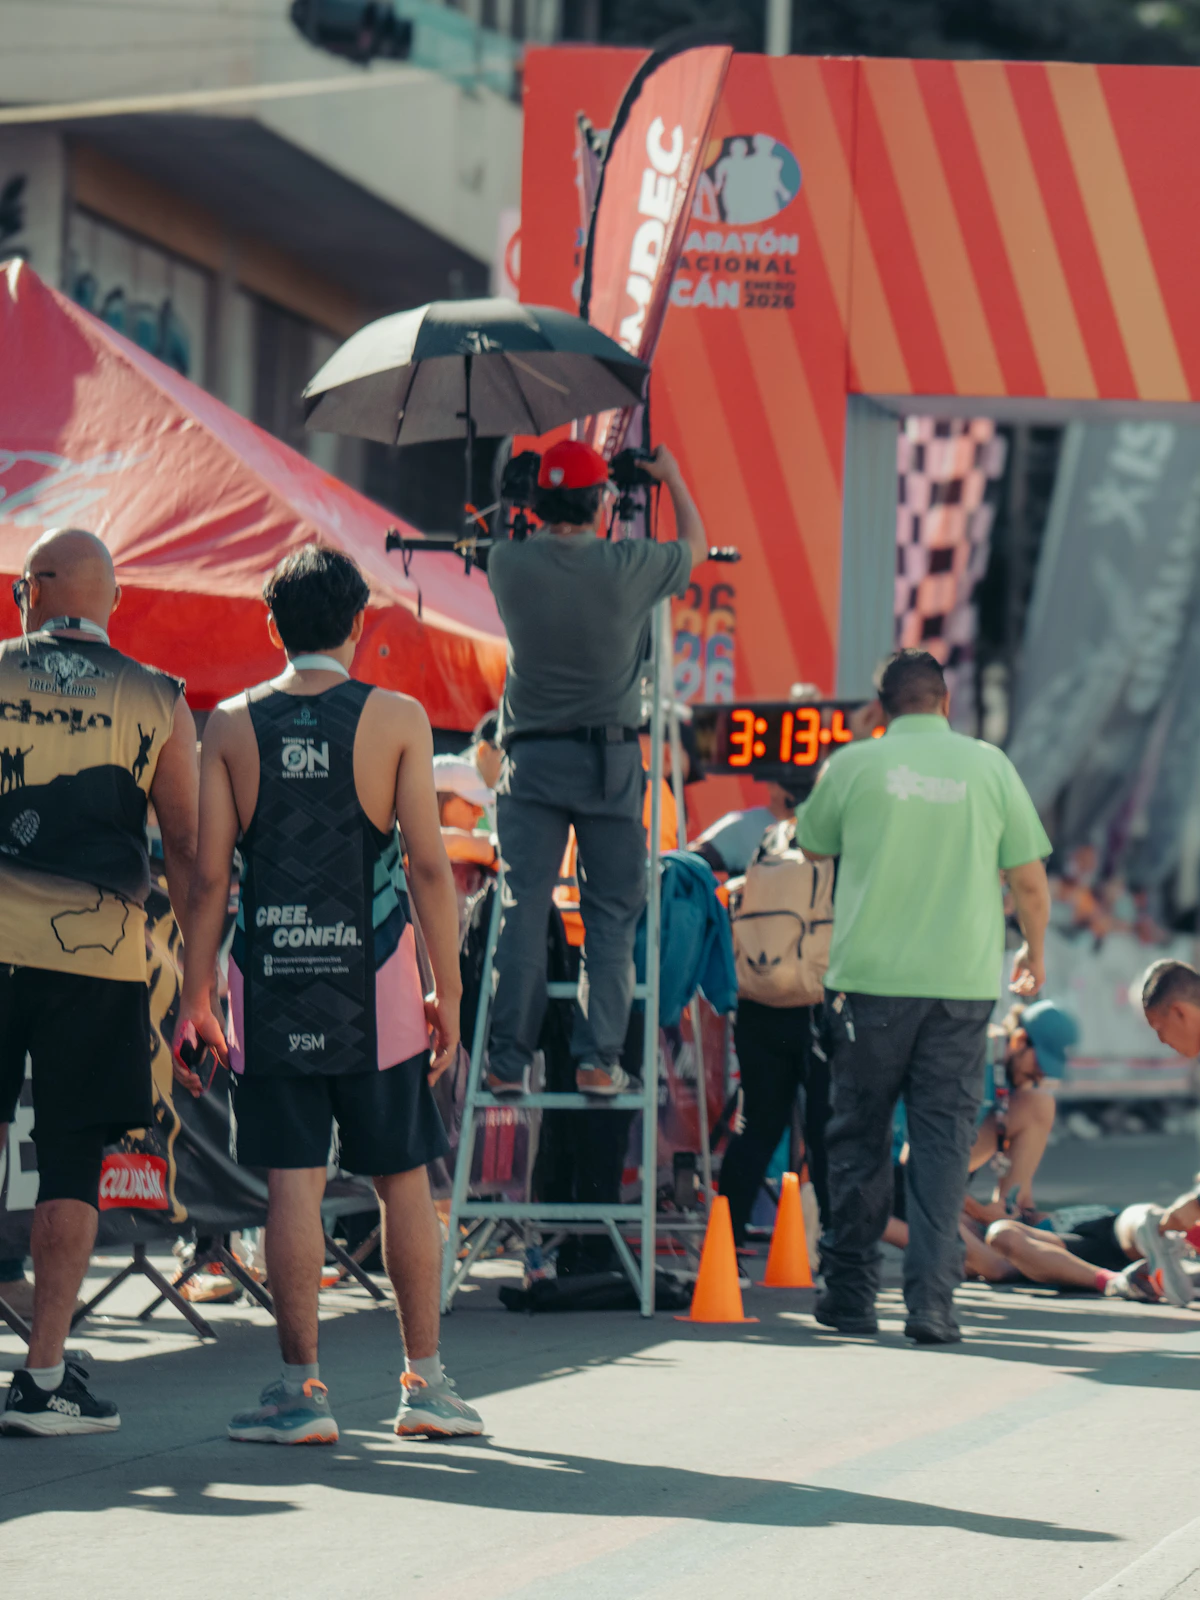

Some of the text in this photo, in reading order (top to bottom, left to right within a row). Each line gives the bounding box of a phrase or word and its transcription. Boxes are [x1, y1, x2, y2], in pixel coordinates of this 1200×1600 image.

[683, 228, 799, 256] ARATÓN
[677, 255, 797, 275] ACIONAL
[669, 272, 740, 308] CÁN
[744, 294, 795, 310] 2026
[281, 741, 330, 772] ON
[46, 1394, 82, 1418] HOKA
